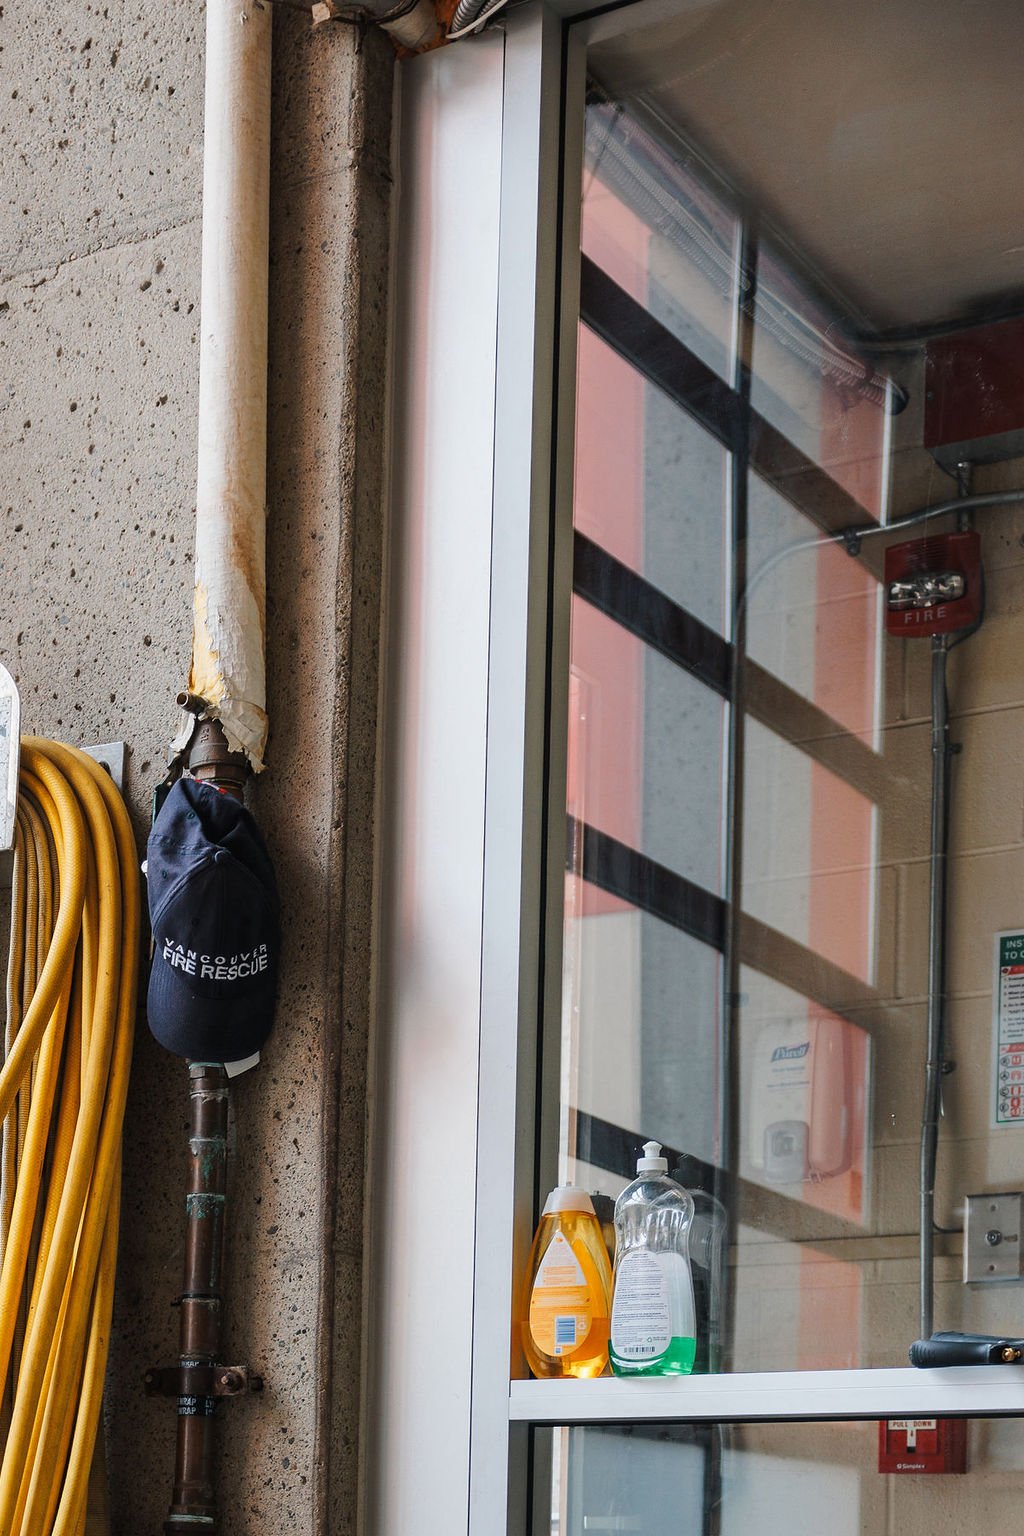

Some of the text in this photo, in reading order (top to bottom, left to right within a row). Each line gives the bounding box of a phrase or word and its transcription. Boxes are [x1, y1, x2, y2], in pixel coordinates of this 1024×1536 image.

[904, 608, 946, 624] FIRE
[164, 937, 268, 966] VANCOUVER
[163, 945, 269, 981] FIRE RESCUE
[892, 1420, 932, 1428] PULL DOWN
